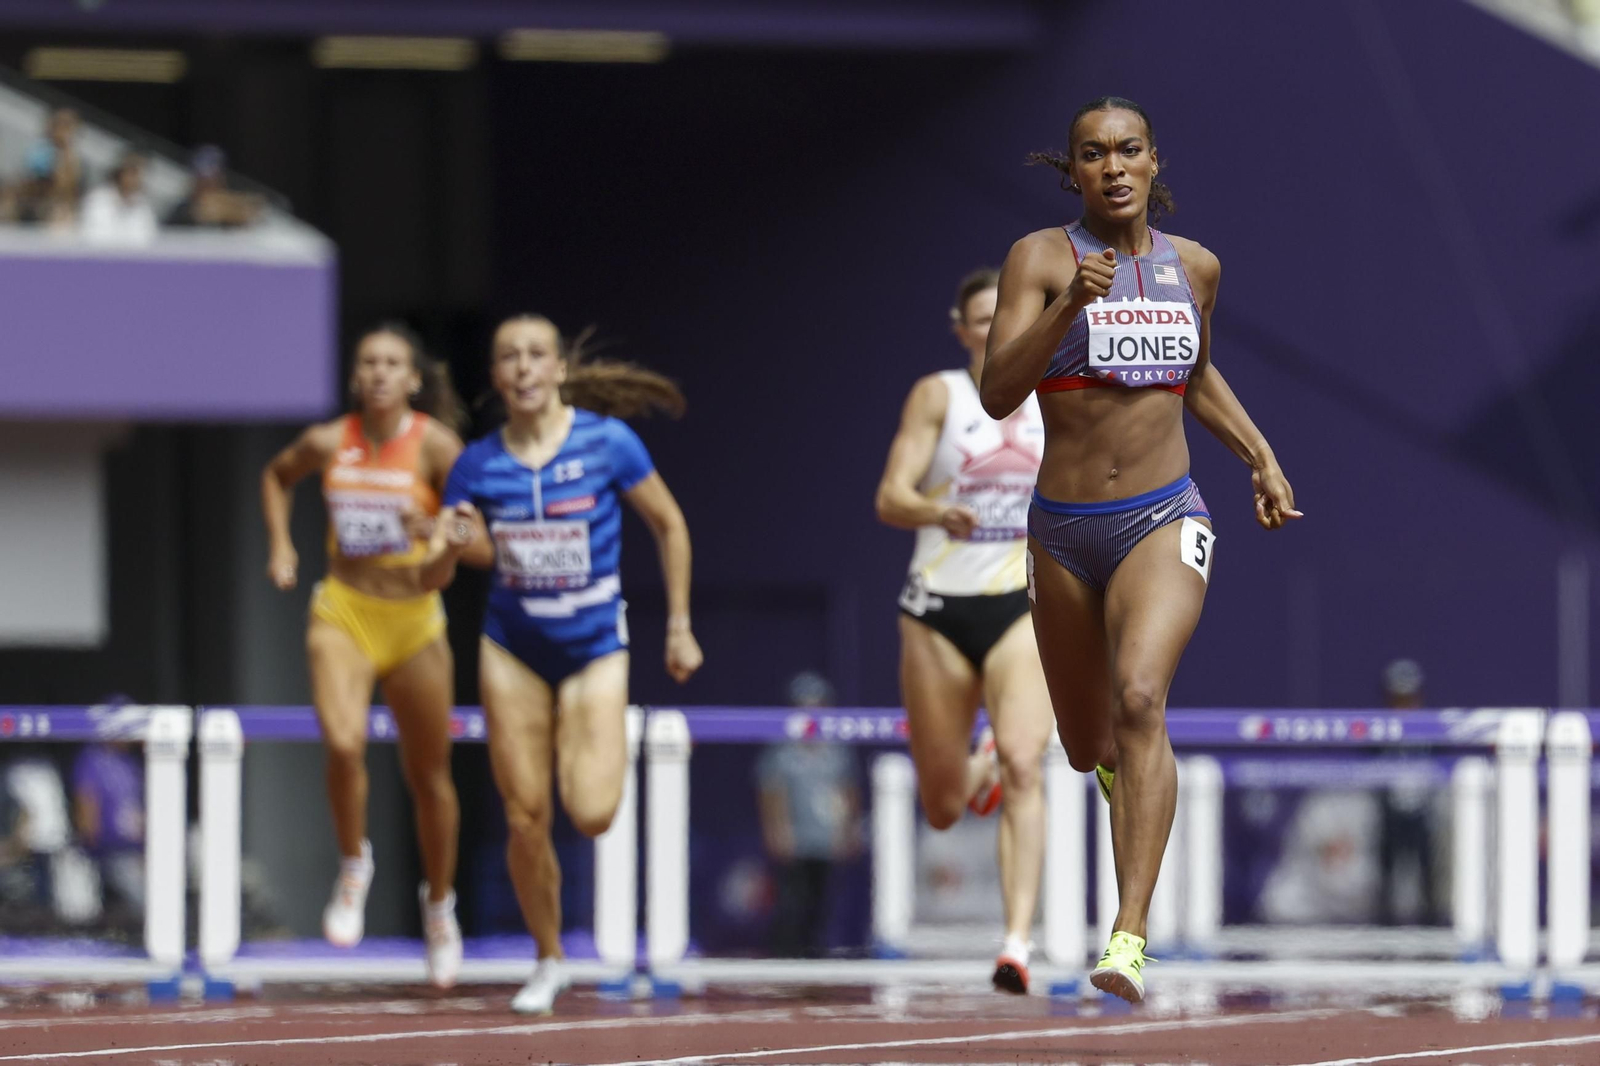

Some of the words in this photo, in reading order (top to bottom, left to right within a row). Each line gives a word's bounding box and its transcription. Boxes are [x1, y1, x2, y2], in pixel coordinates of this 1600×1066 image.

[1089, 309, 1193, 325] HONDA
[1096, 335, 1194, 363] JONES
[1120, 369, 1176, 381] TOKYO
[1194, 530, 1208, 568] 5
